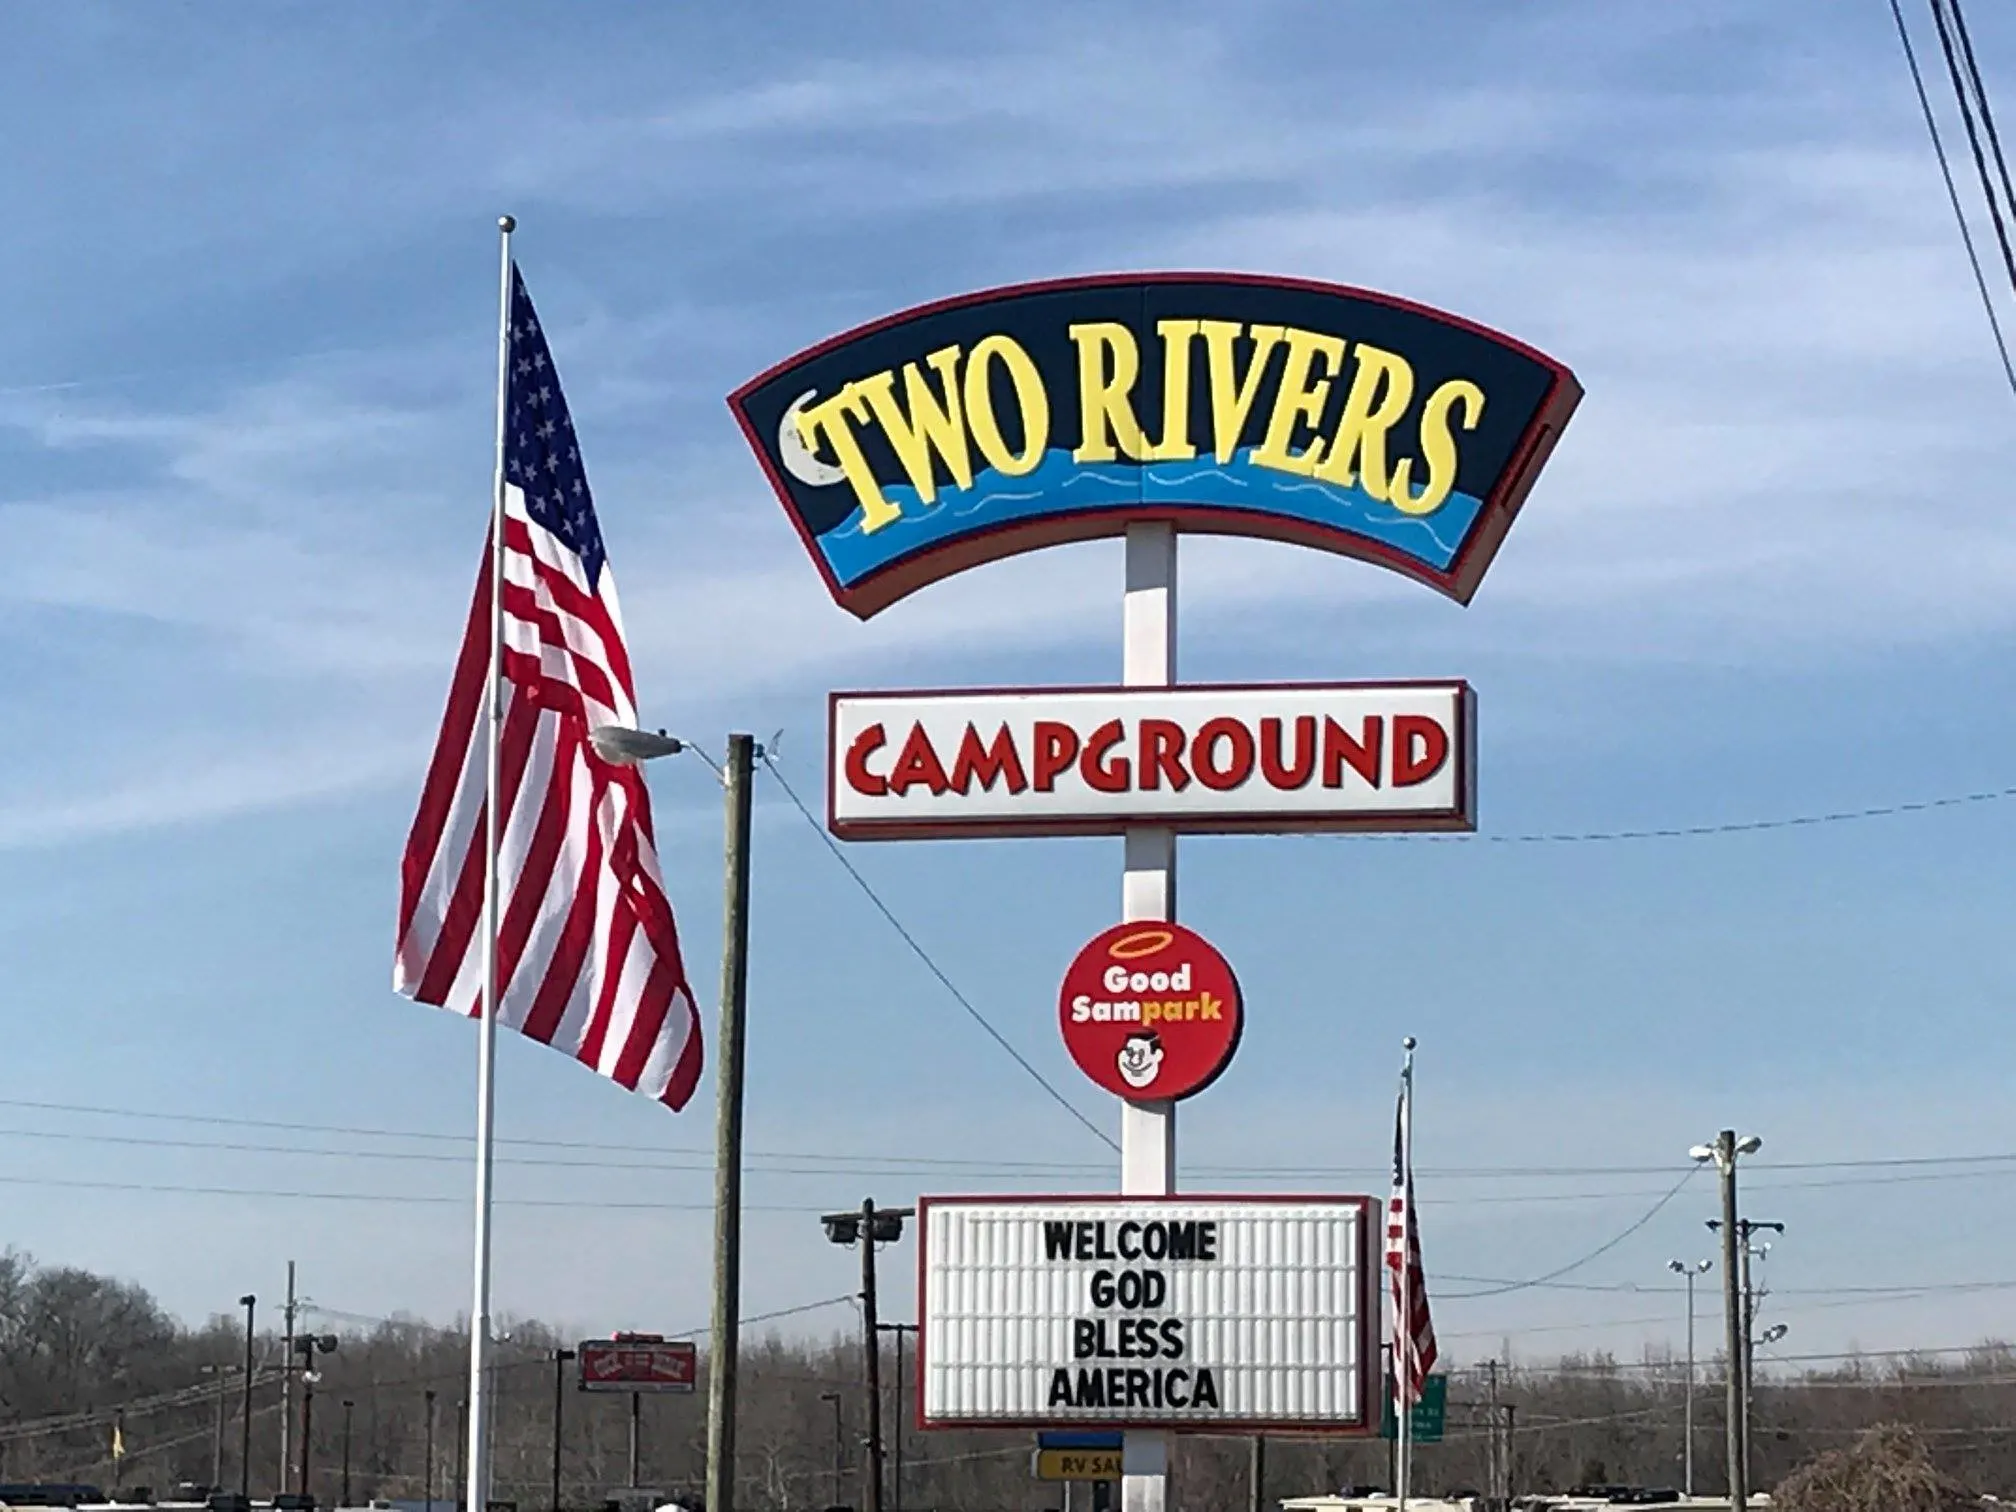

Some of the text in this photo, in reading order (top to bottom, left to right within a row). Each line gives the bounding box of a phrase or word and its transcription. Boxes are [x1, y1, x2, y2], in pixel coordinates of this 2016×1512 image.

[793, 318, 1486, 535] TWO RIVERS
[844, 714, 1450, 796] CAMPGROUND
[1103, 963, 1192, 993] Good
[1044, 1220, 1217, 1261] WELCOME
[1090, 1269, 1167, 1309] GOD
[1074, 1318, 1184, 1360] BLESS
[1048, 1367, 1219, 1409] AMERICA
[1061, 1456, 1087, 1474] RV
